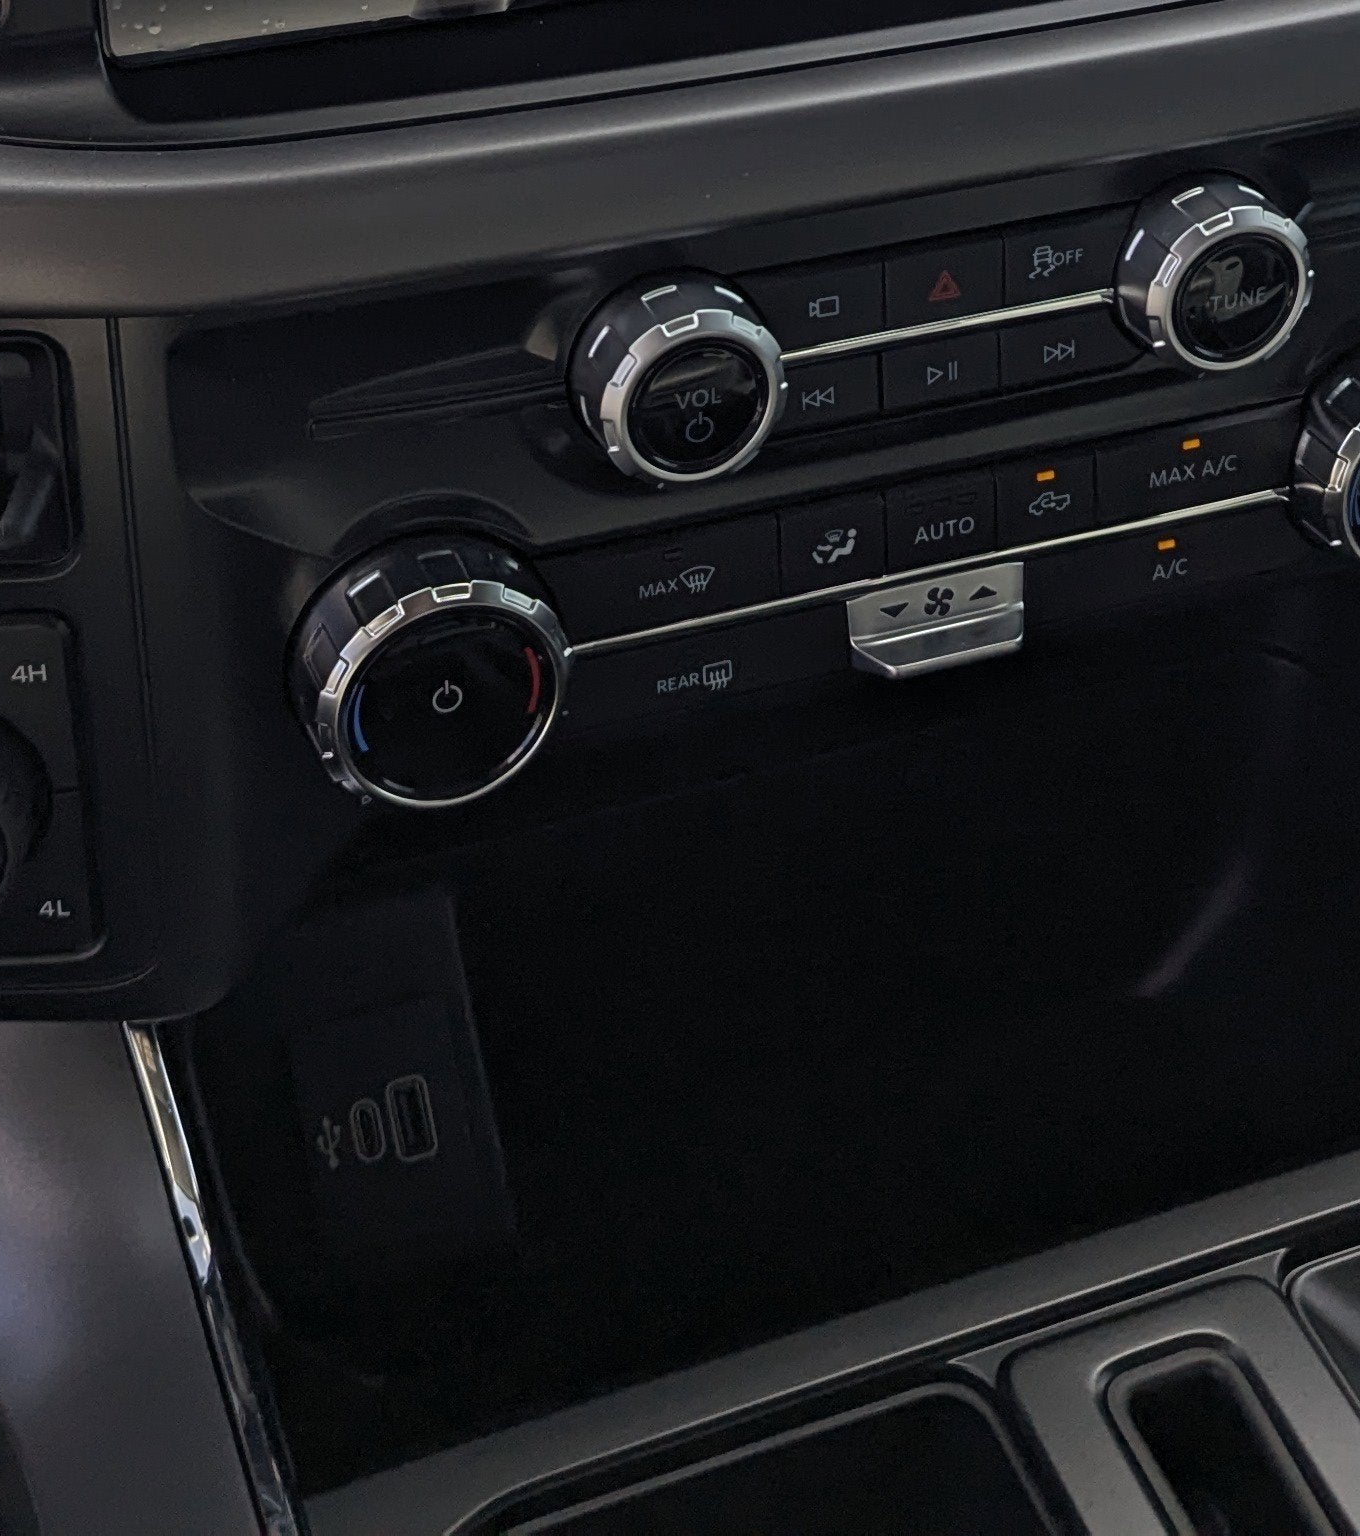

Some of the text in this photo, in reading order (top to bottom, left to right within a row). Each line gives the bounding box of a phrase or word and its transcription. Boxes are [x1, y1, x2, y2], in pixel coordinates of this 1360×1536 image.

[1052, 249, 1084, 267] OFF
[1210, 290, 1268, 312] TUNE
[675, 384, 722, 409] VOL
[1149, 454, 1238, 488] MAX A/C
[914, 516, 975, 545] AUTO
[1152, 557, 1188, 581] A/C
[639, 578, 679, 599] MAX
[11, 663, 47, 683] 4H
[656, 672, 700, 694] REAR
[39, 899, 71, 917] 4L
